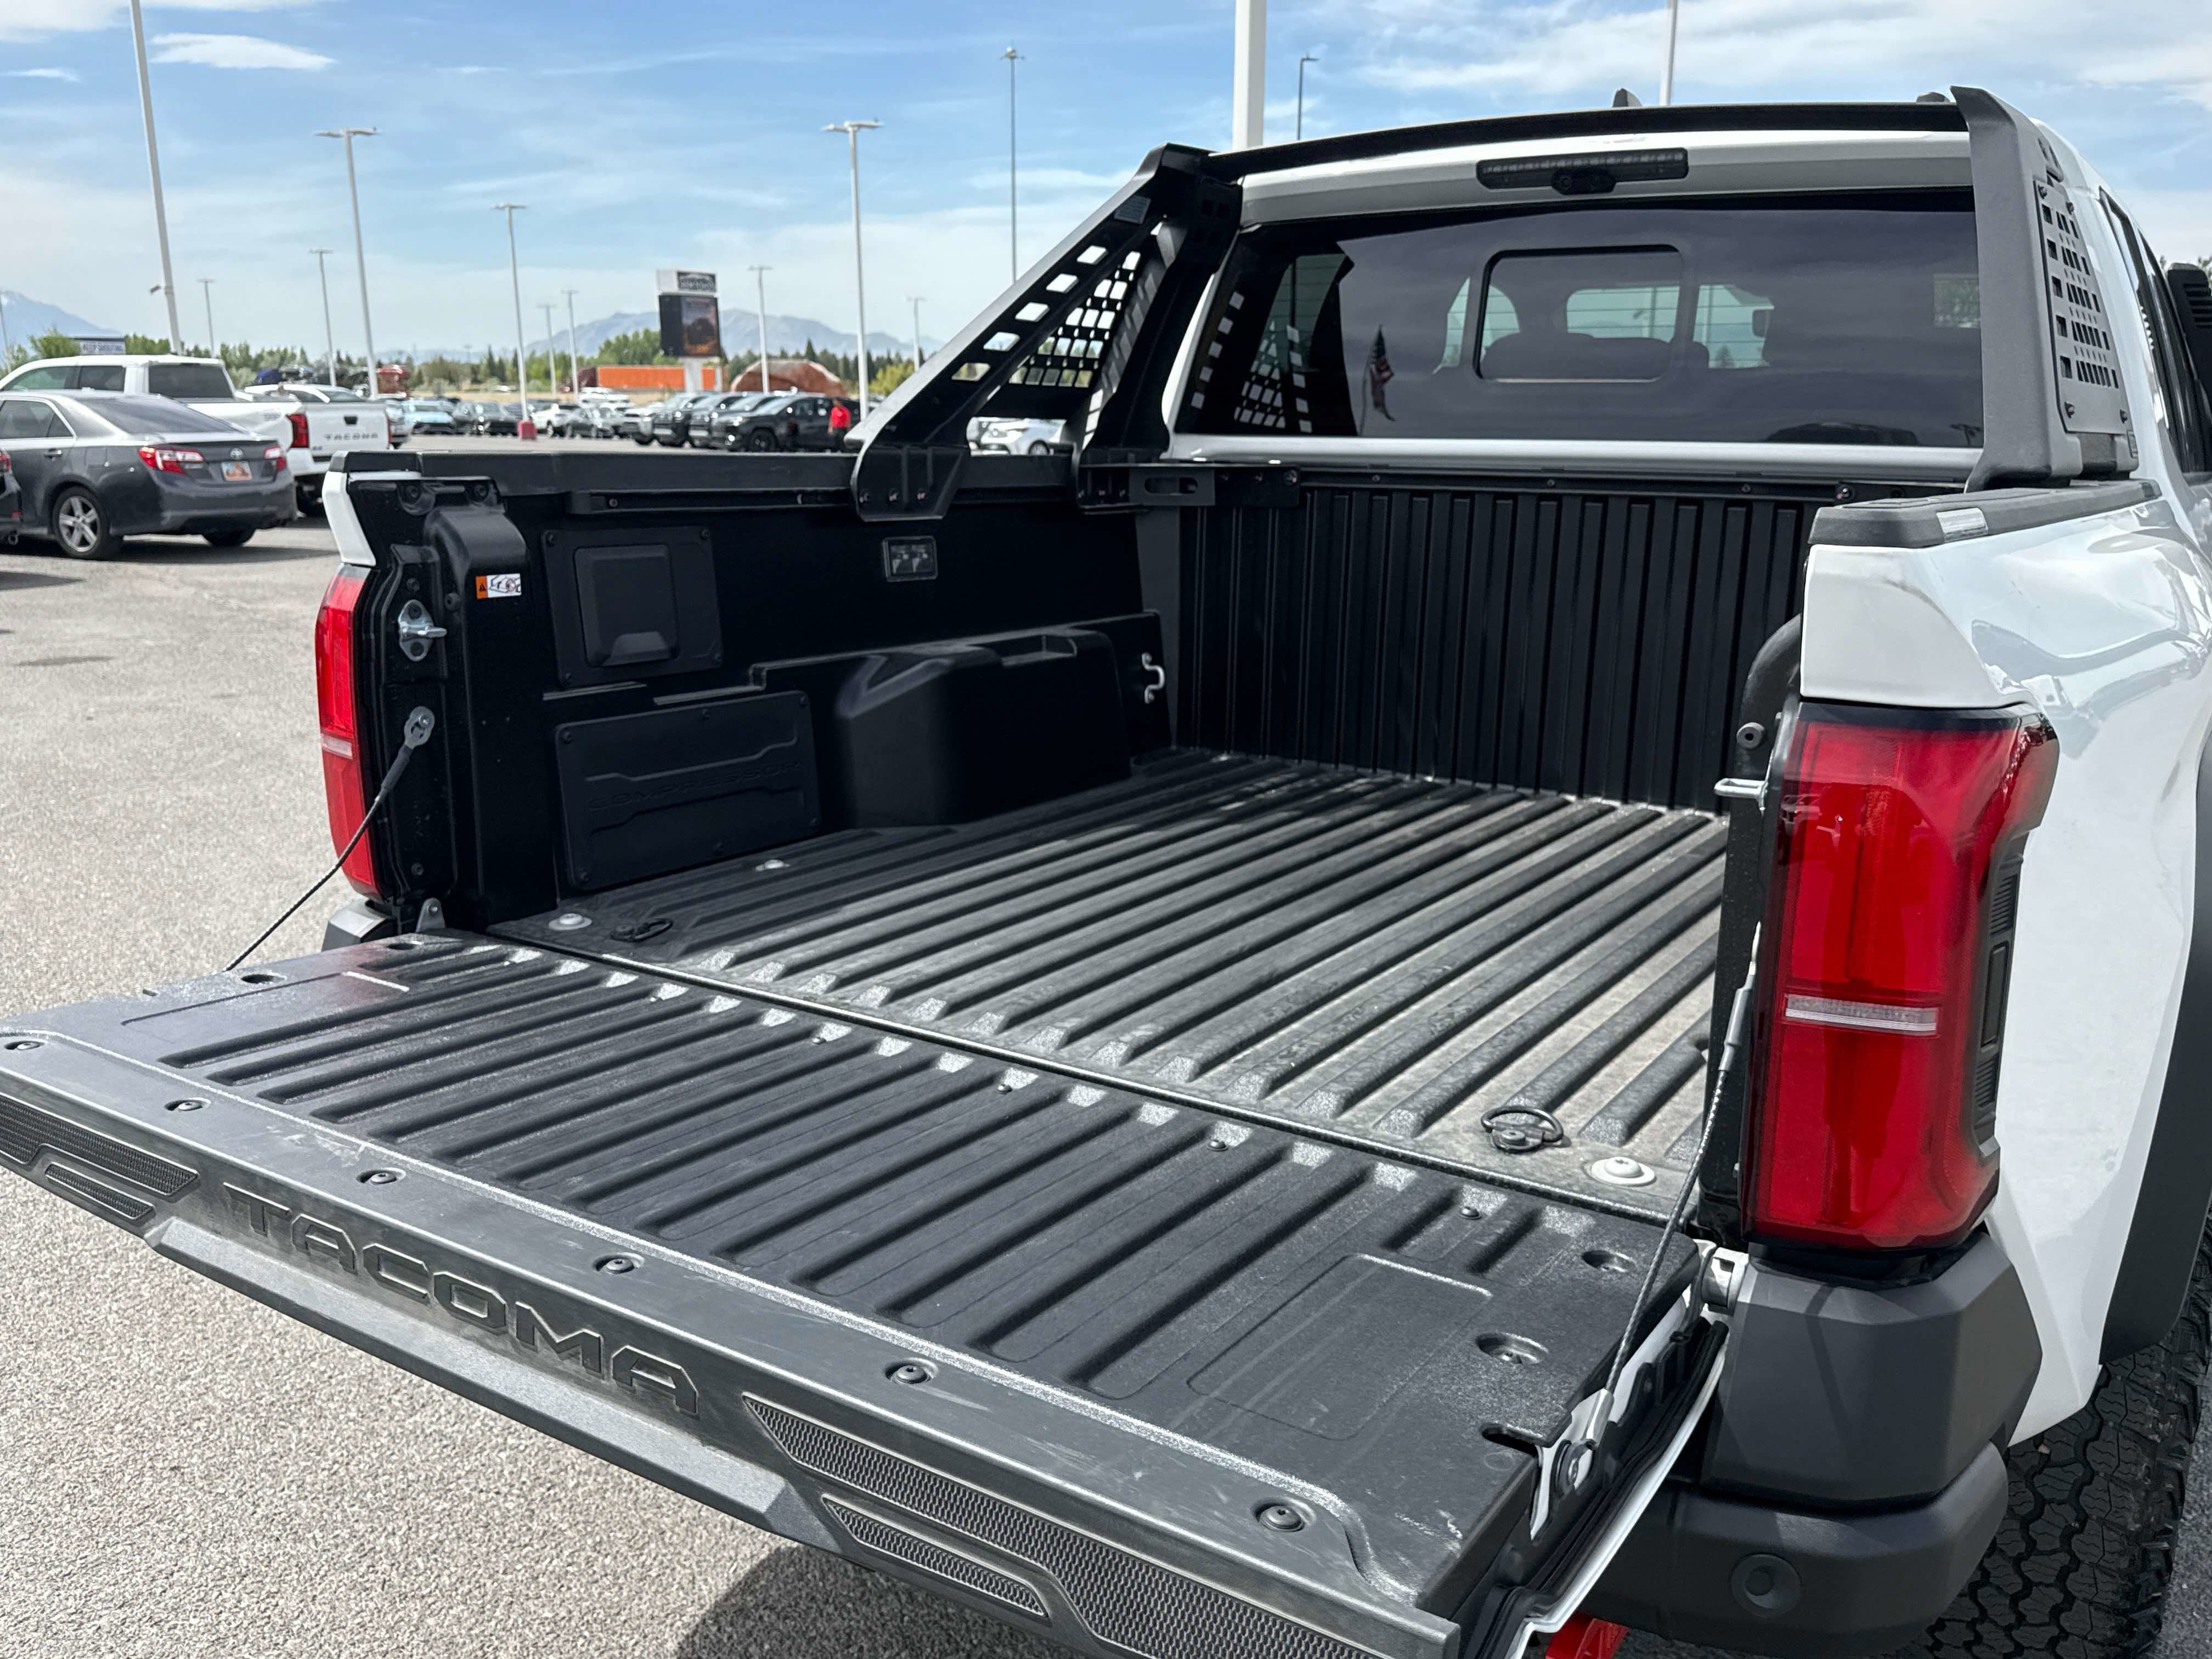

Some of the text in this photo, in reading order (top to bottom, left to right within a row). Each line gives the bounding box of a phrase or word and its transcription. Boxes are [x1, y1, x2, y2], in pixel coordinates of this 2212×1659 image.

[325, 432, 379, 441] TACOMA
[588, 761, 800, 811] COMPRESSOR
[222, 1182, 701, 1420] TACOMA
